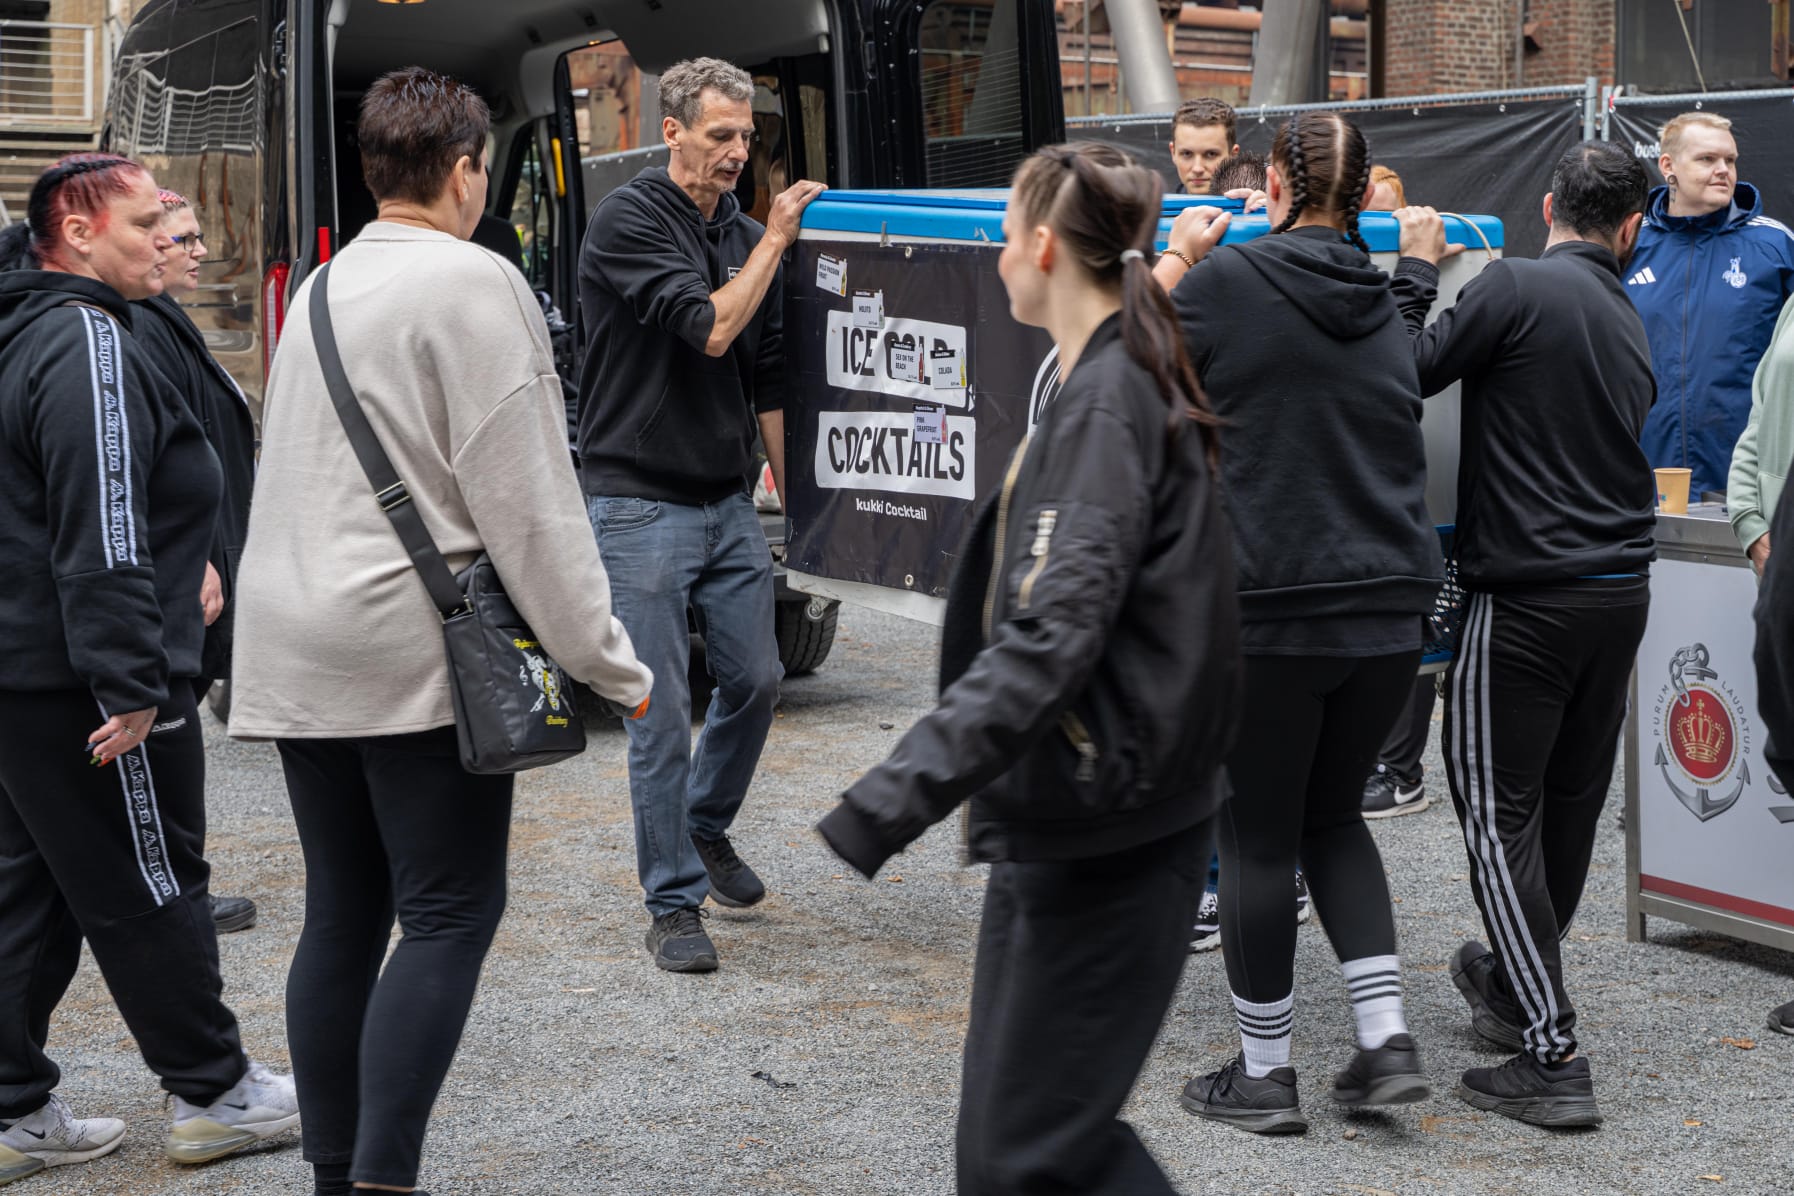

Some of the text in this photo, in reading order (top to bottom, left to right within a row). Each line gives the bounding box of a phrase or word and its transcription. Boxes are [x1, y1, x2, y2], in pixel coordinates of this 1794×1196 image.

[98, 333, 114, 385] Kappa
[842, 326, 878, 377] ICE
[895, 362, 906, 370] BEACH
[938, 366, 953, 375] COLADA
[104, 411, 121, 472] Kappa
[828, 426, 965, 482] COCKTAILS
[916, 425, 938, 433] GRAPEFRUIT
[110, 501, 128, 561] Kappa
[856, 497, 928, 521] kukki Cocktail
[1653, 680, 1751, 755] PURUM LAUDATUR
[131, 770, 152, 825] Kappa
[147, 846, 173, 897] Kappa
